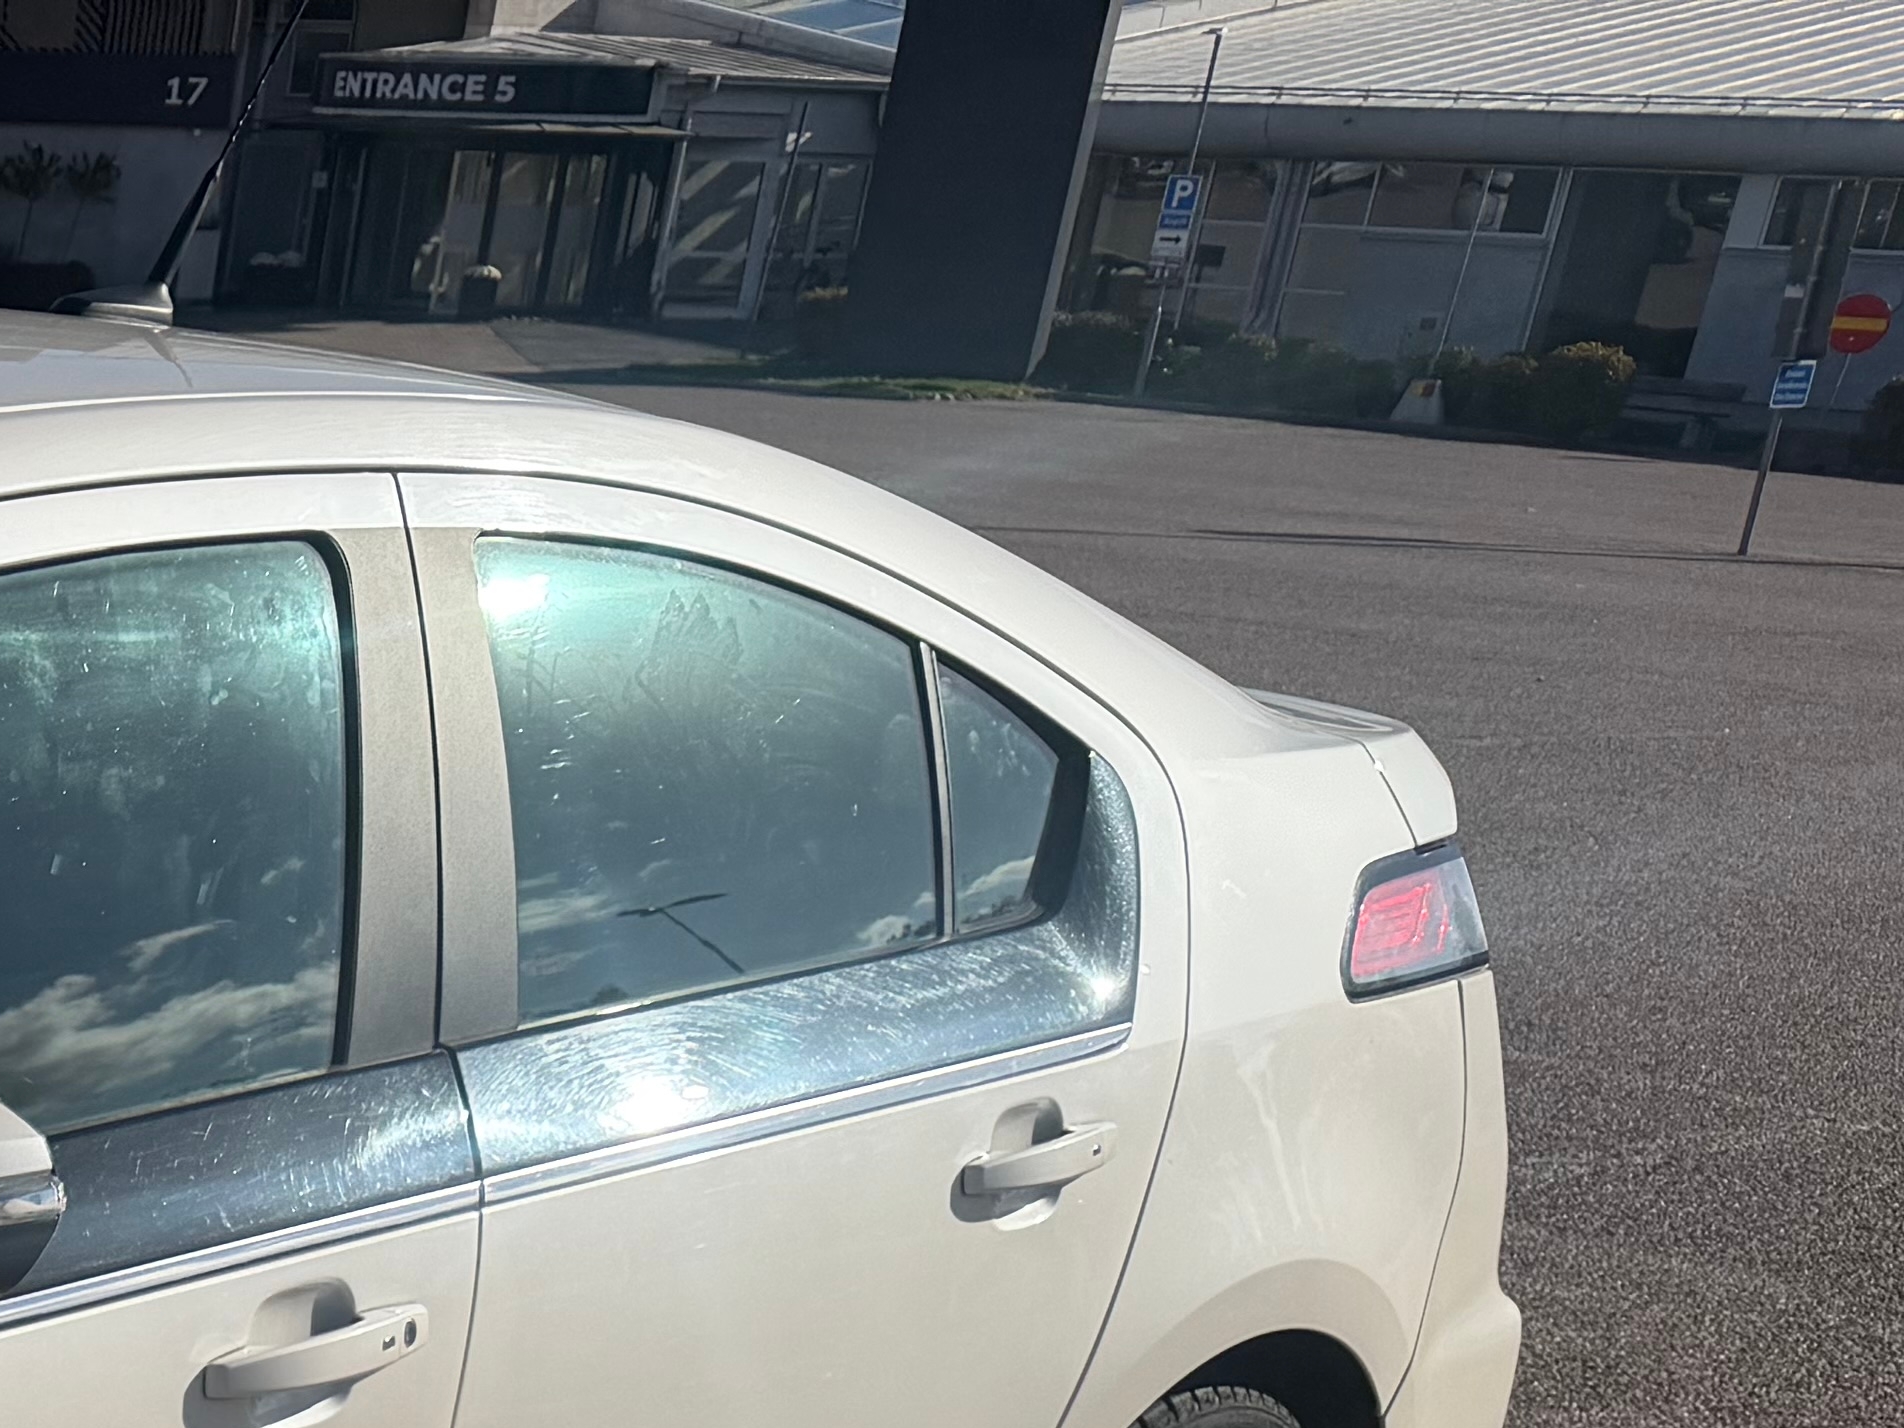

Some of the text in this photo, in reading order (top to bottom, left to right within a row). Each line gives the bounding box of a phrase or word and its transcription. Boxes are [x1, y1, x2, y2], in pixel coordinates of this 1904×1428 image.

[164, 76, 209, 106] 17
[334, 70, 516, 103] ENTRANCE 5
[1171, 179, 1194, 208] P
